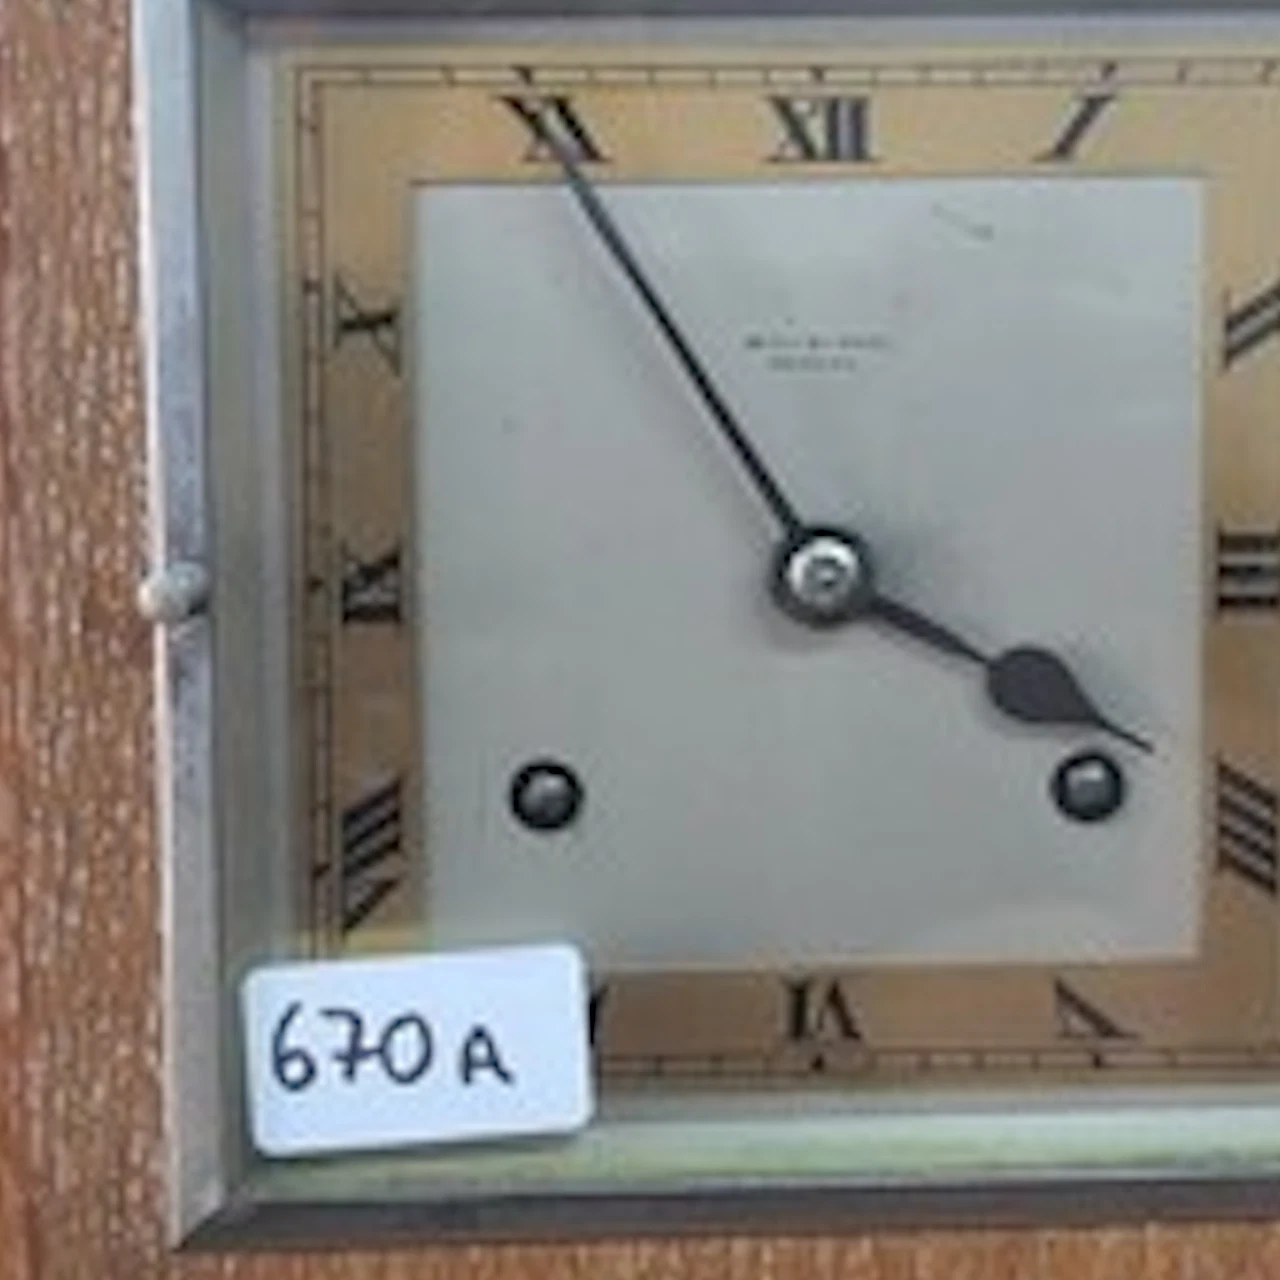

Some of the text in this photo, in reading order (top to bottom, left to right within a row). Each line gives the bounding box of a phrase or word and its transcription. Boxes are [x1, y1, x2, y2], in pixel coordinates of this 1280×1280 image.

[765, 94, 876, 164] XII
[1033, 94, 1118, 162] I
[332, 273, 402, 376] X
[340, 546, 404, 626] IX
[340, 778, 404, 936] VIII
[784, 978, 864, 1044] VI
[1054, 980, 1134, 1040] V
